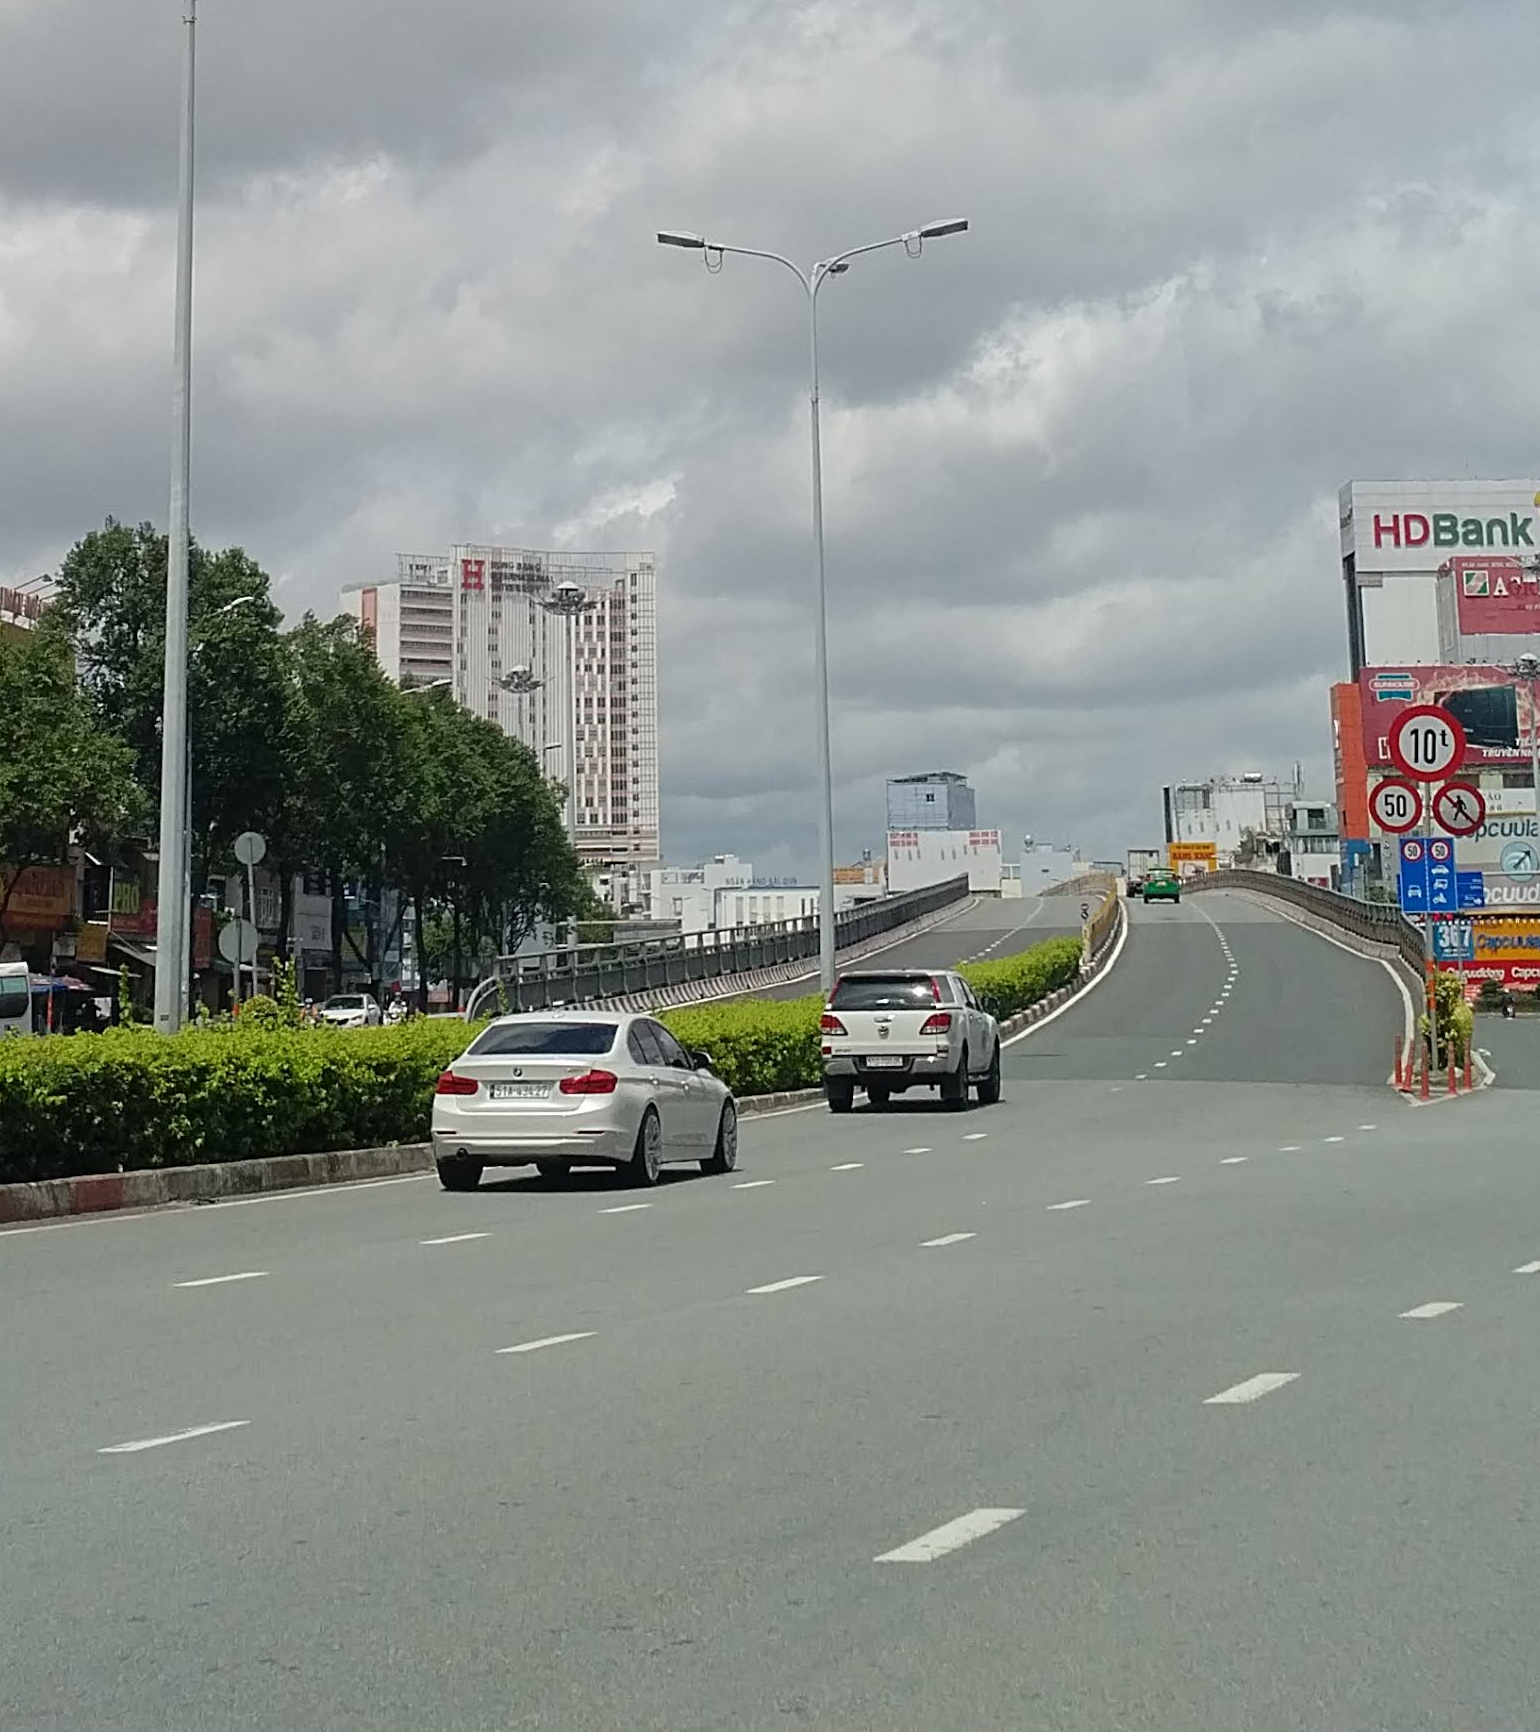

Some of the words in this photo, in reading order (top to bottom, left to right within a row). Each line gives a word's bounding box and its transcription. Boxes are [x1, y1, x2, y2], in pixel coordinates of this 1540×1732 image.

[1373, 512, 1535, 548] HDBank
[1384, 794, 1407, 818] 50
[1408, 843, 1418, 856] 50
[1435, 843, 1445, 856] 50
